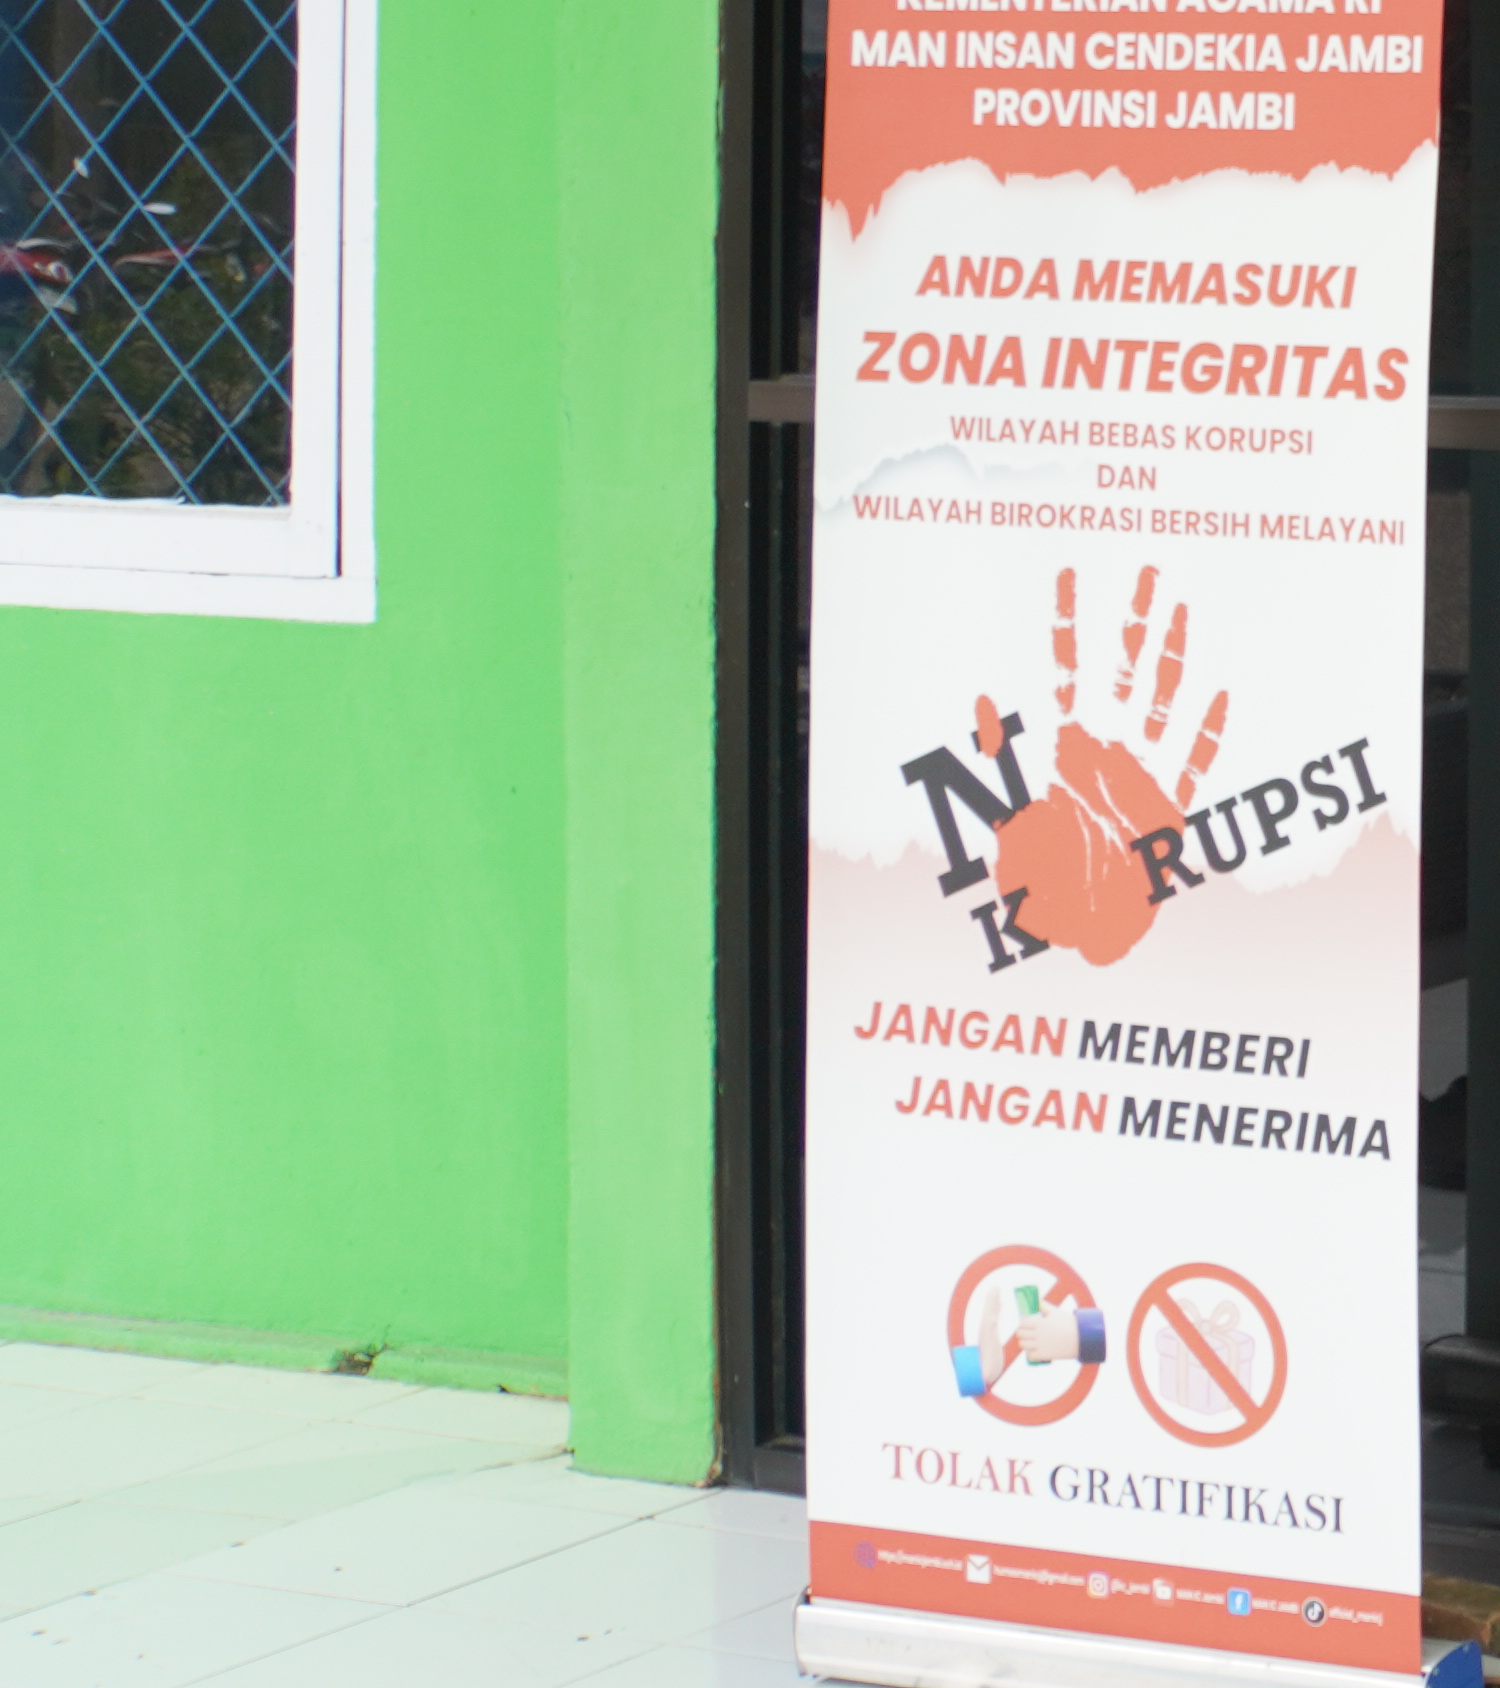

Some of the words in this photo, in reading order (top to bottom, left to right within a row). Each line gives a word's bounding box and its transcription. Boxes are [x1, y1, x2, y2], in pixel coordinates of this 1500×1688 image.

[851, 30, 946, 68] MAN
[956, 31, 1075, 69] INSAN
[1085, 32, 1286, 72] CENDEKIA
[1295, 34, 1423, 73] JAMBI
[973, 88, 1157, 128] PROVINSI
[1165, 91, 1295, 130] JAMBI
[916, 255, 1059, 300] ANDA
[1073, 259, 1356, 308] MEMASUKI
[856, 331, 1026, 387] ZONA
[1042, 337, 1408, 401] INTEGRITAS
[950, 416, 1079, 445] WILAYAH
[1089, 421, 1176, 449] BEBAS
[1185, 426, 1312, 454] KORUPSI
[1097, 464, 1156, 491] DAN
[852, 493, 982, 524] WILAYAH
[991, 501, 1142, 532] BIROKRASI
[1151, 509, 1250, 537] BERSIH
[1260, 514, 1404, 545] MELAYANI
[854, 1002, 1067, 1056] JANGAN
[1079, 1020, 1310, 1078] MEMBERI
[895, 1076, 1108, 1133] JANGAN
[1119, 1096, 1390, 1160] MENERIMA
[883, 1443, 1032, 1495] TOLAK
[1050, 1465, 1345, 1532] GRATIFIKASI
